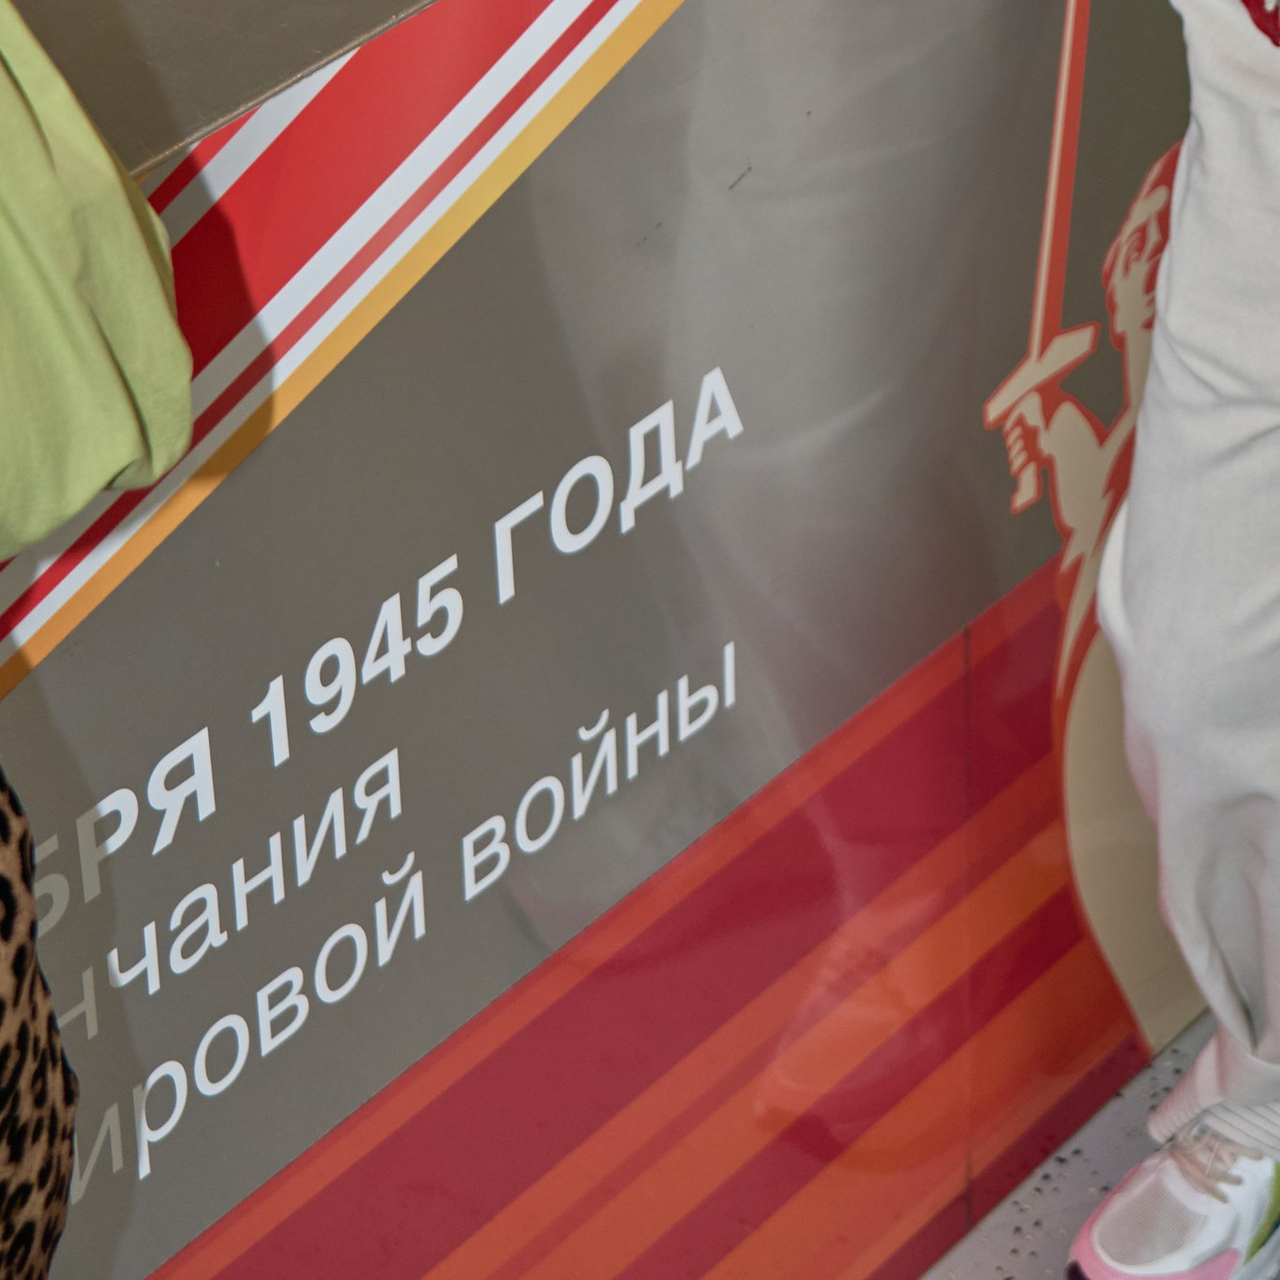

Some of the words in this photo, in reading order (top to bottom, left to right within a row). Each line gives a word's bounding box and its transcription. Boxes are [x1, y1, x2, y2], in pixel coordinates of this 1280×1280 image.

[251, 553, 464, 768] 1945
[494, 365, 745, 606] ГОДА
[462, 641, 737, 903] войны
